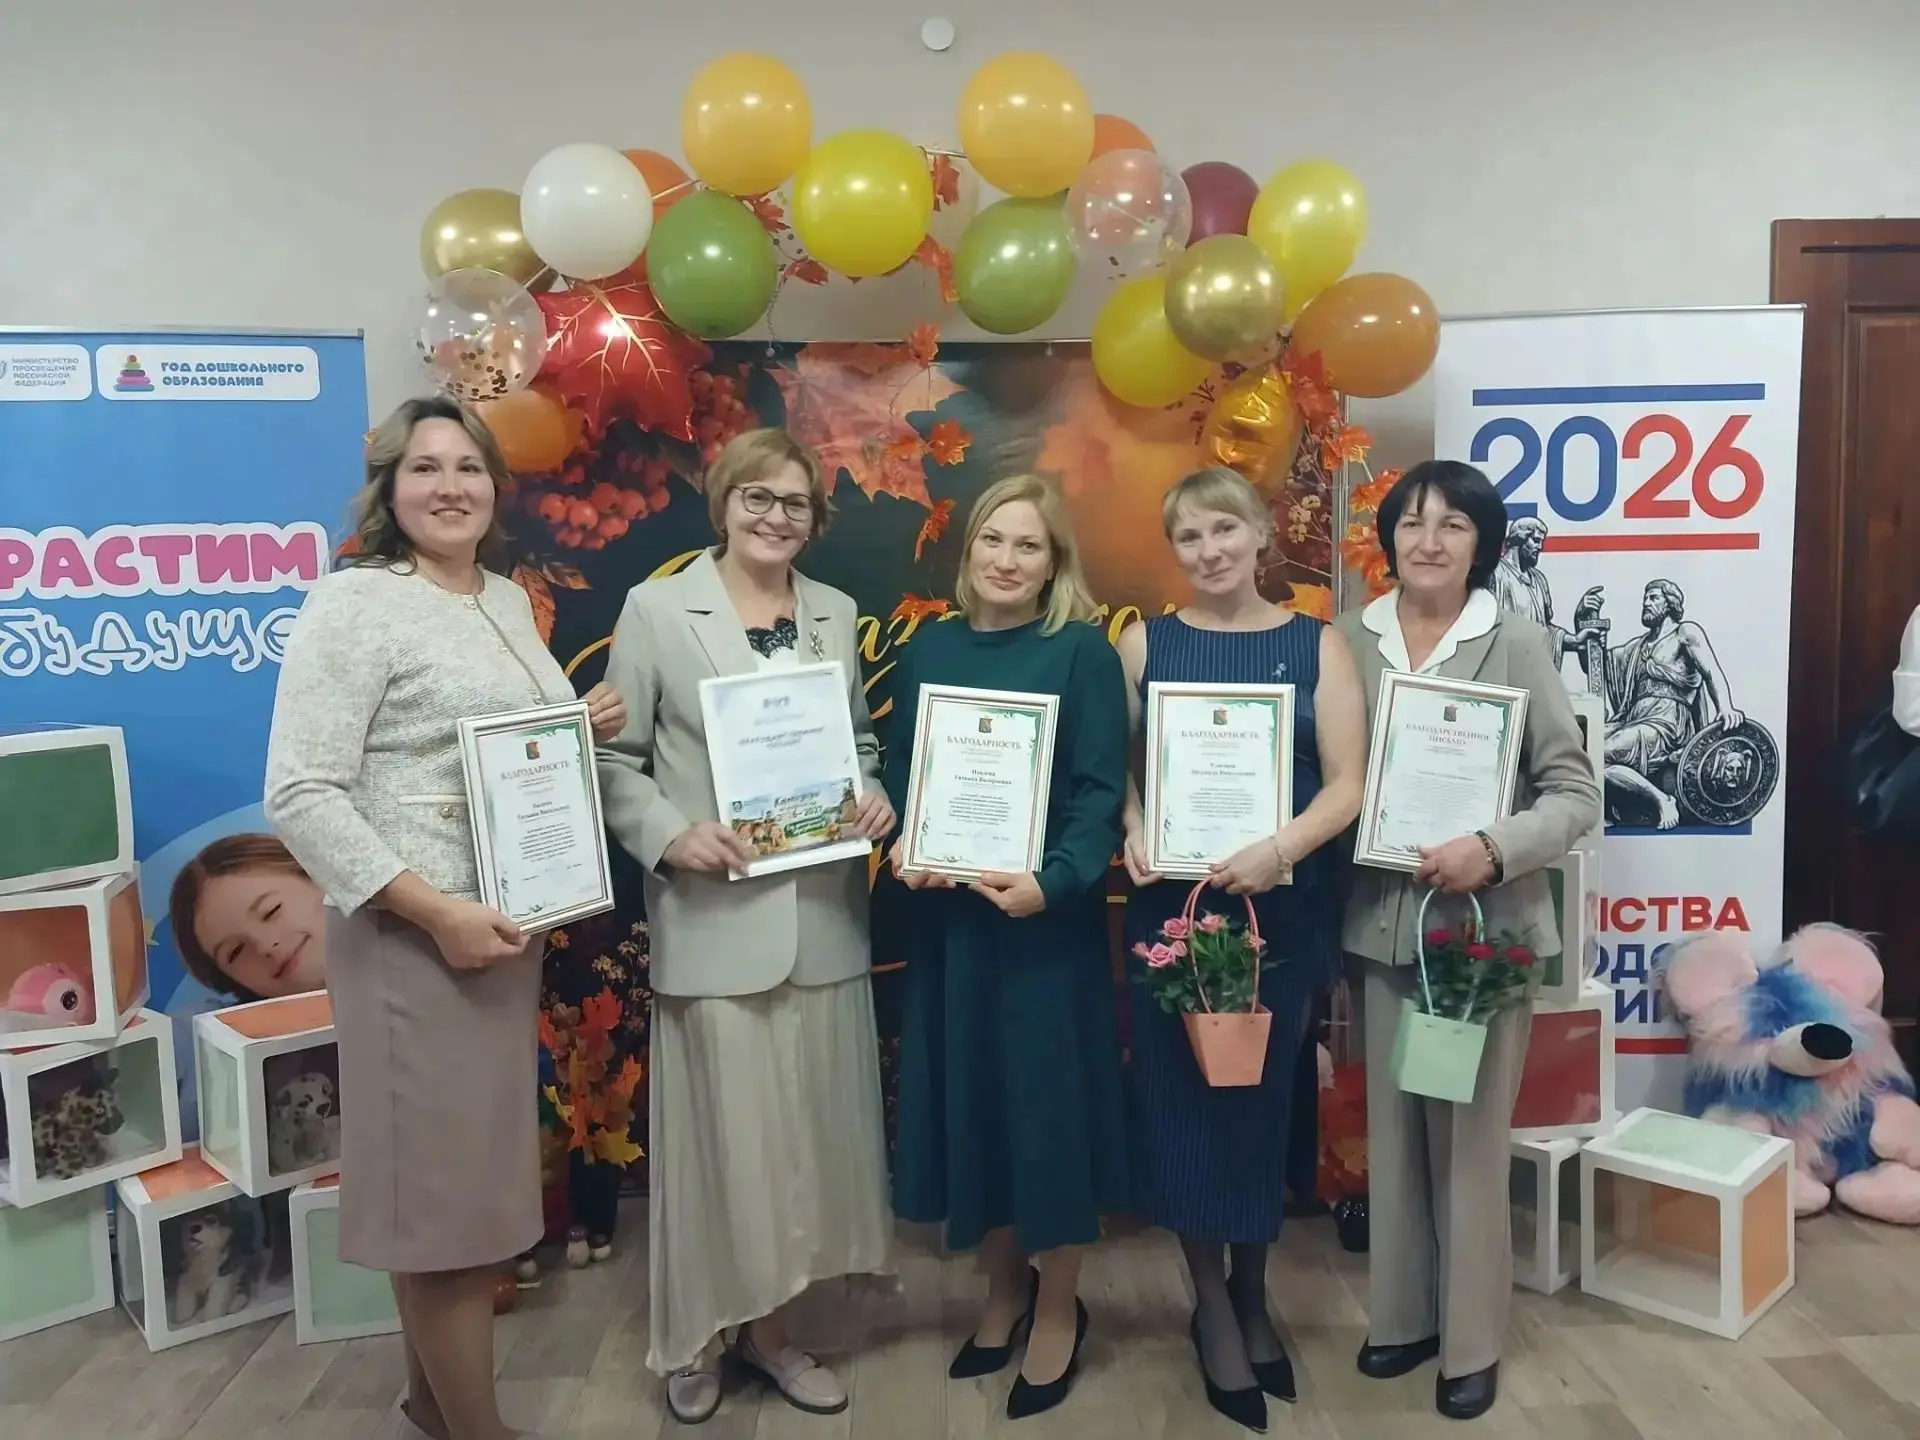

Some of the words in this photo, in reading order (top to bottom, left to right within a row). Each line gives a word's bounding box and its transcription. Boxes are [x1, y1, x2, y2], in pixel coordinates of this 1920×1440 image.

[160, 361, 192, 373] ГОД
[194, 361, 305, 373] ДОШКОЛЬНОГО
[162, 375, 264, 387] ОБРАЗОВАНИЯ
[1469, 413, 1765, 522] 2026
[0, 530, 320, 592] РАСТИМ
